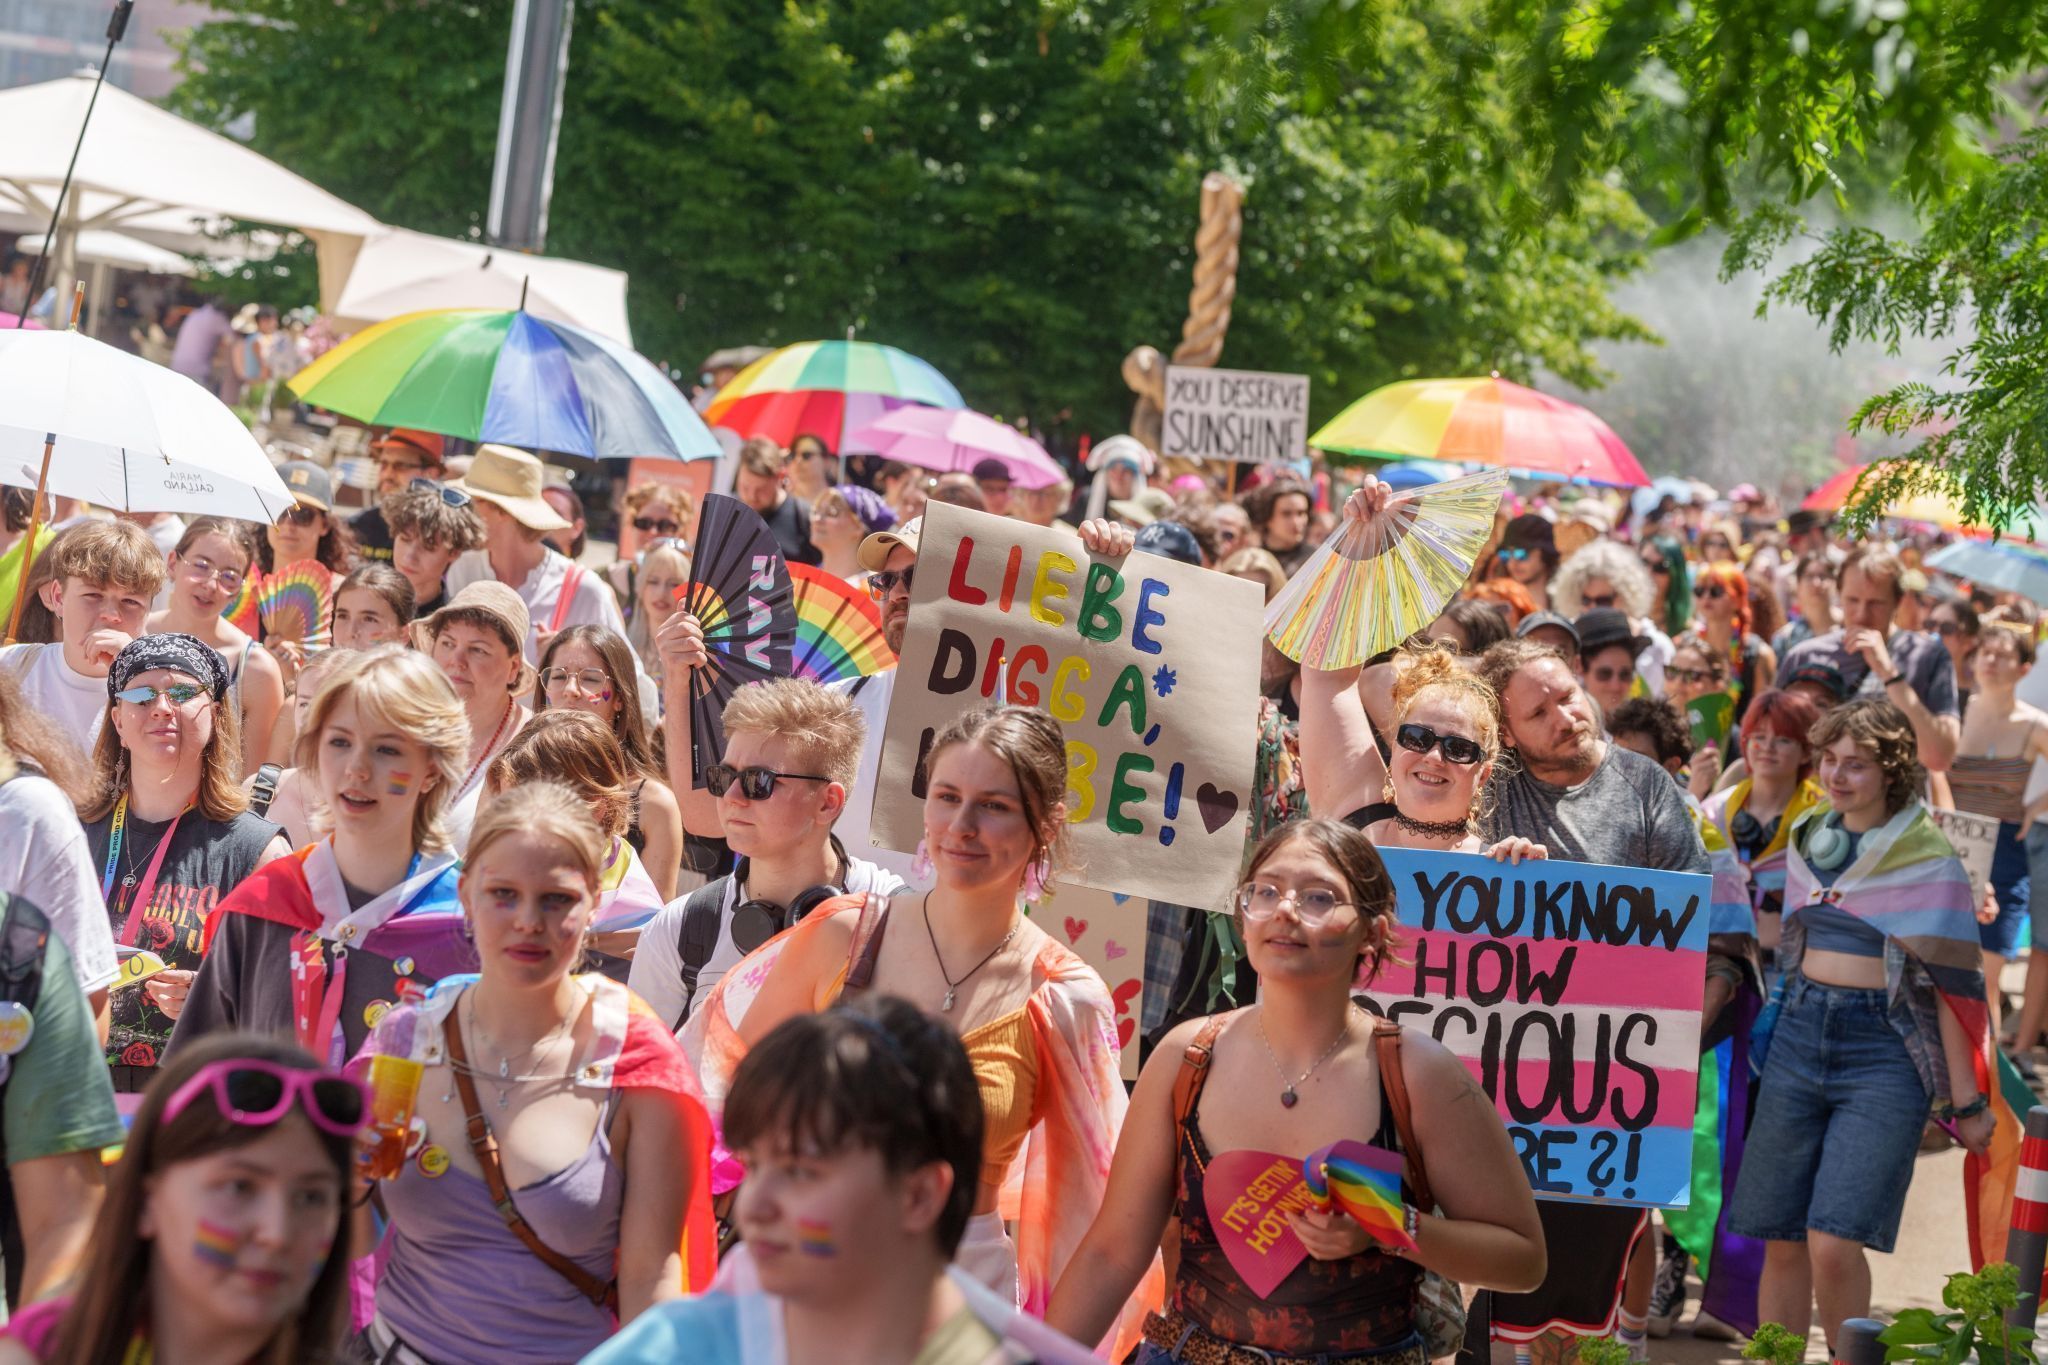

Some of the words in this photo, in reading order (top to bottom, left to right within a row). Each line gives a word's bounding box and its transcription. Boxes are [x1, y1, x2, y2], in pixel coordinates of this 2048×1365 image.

[1171, 377, 1212, 405] YOU
[1219, 378, 1304, 413] DESERVE
[1168, 410, 1300, 460] SUNSHINE
[948, 536, 1170, 655] LIEBE
[745, 555, 778, 688] RAV
[112, 825, 121, 851] PROUD
[108, 853, 117, 874] PRIDE
[1414, 937, 1578, 1007] HOW
[1221, 1196, 1261, 1233] IT'S
[1245, 1207, 1292, 1256] HOT
